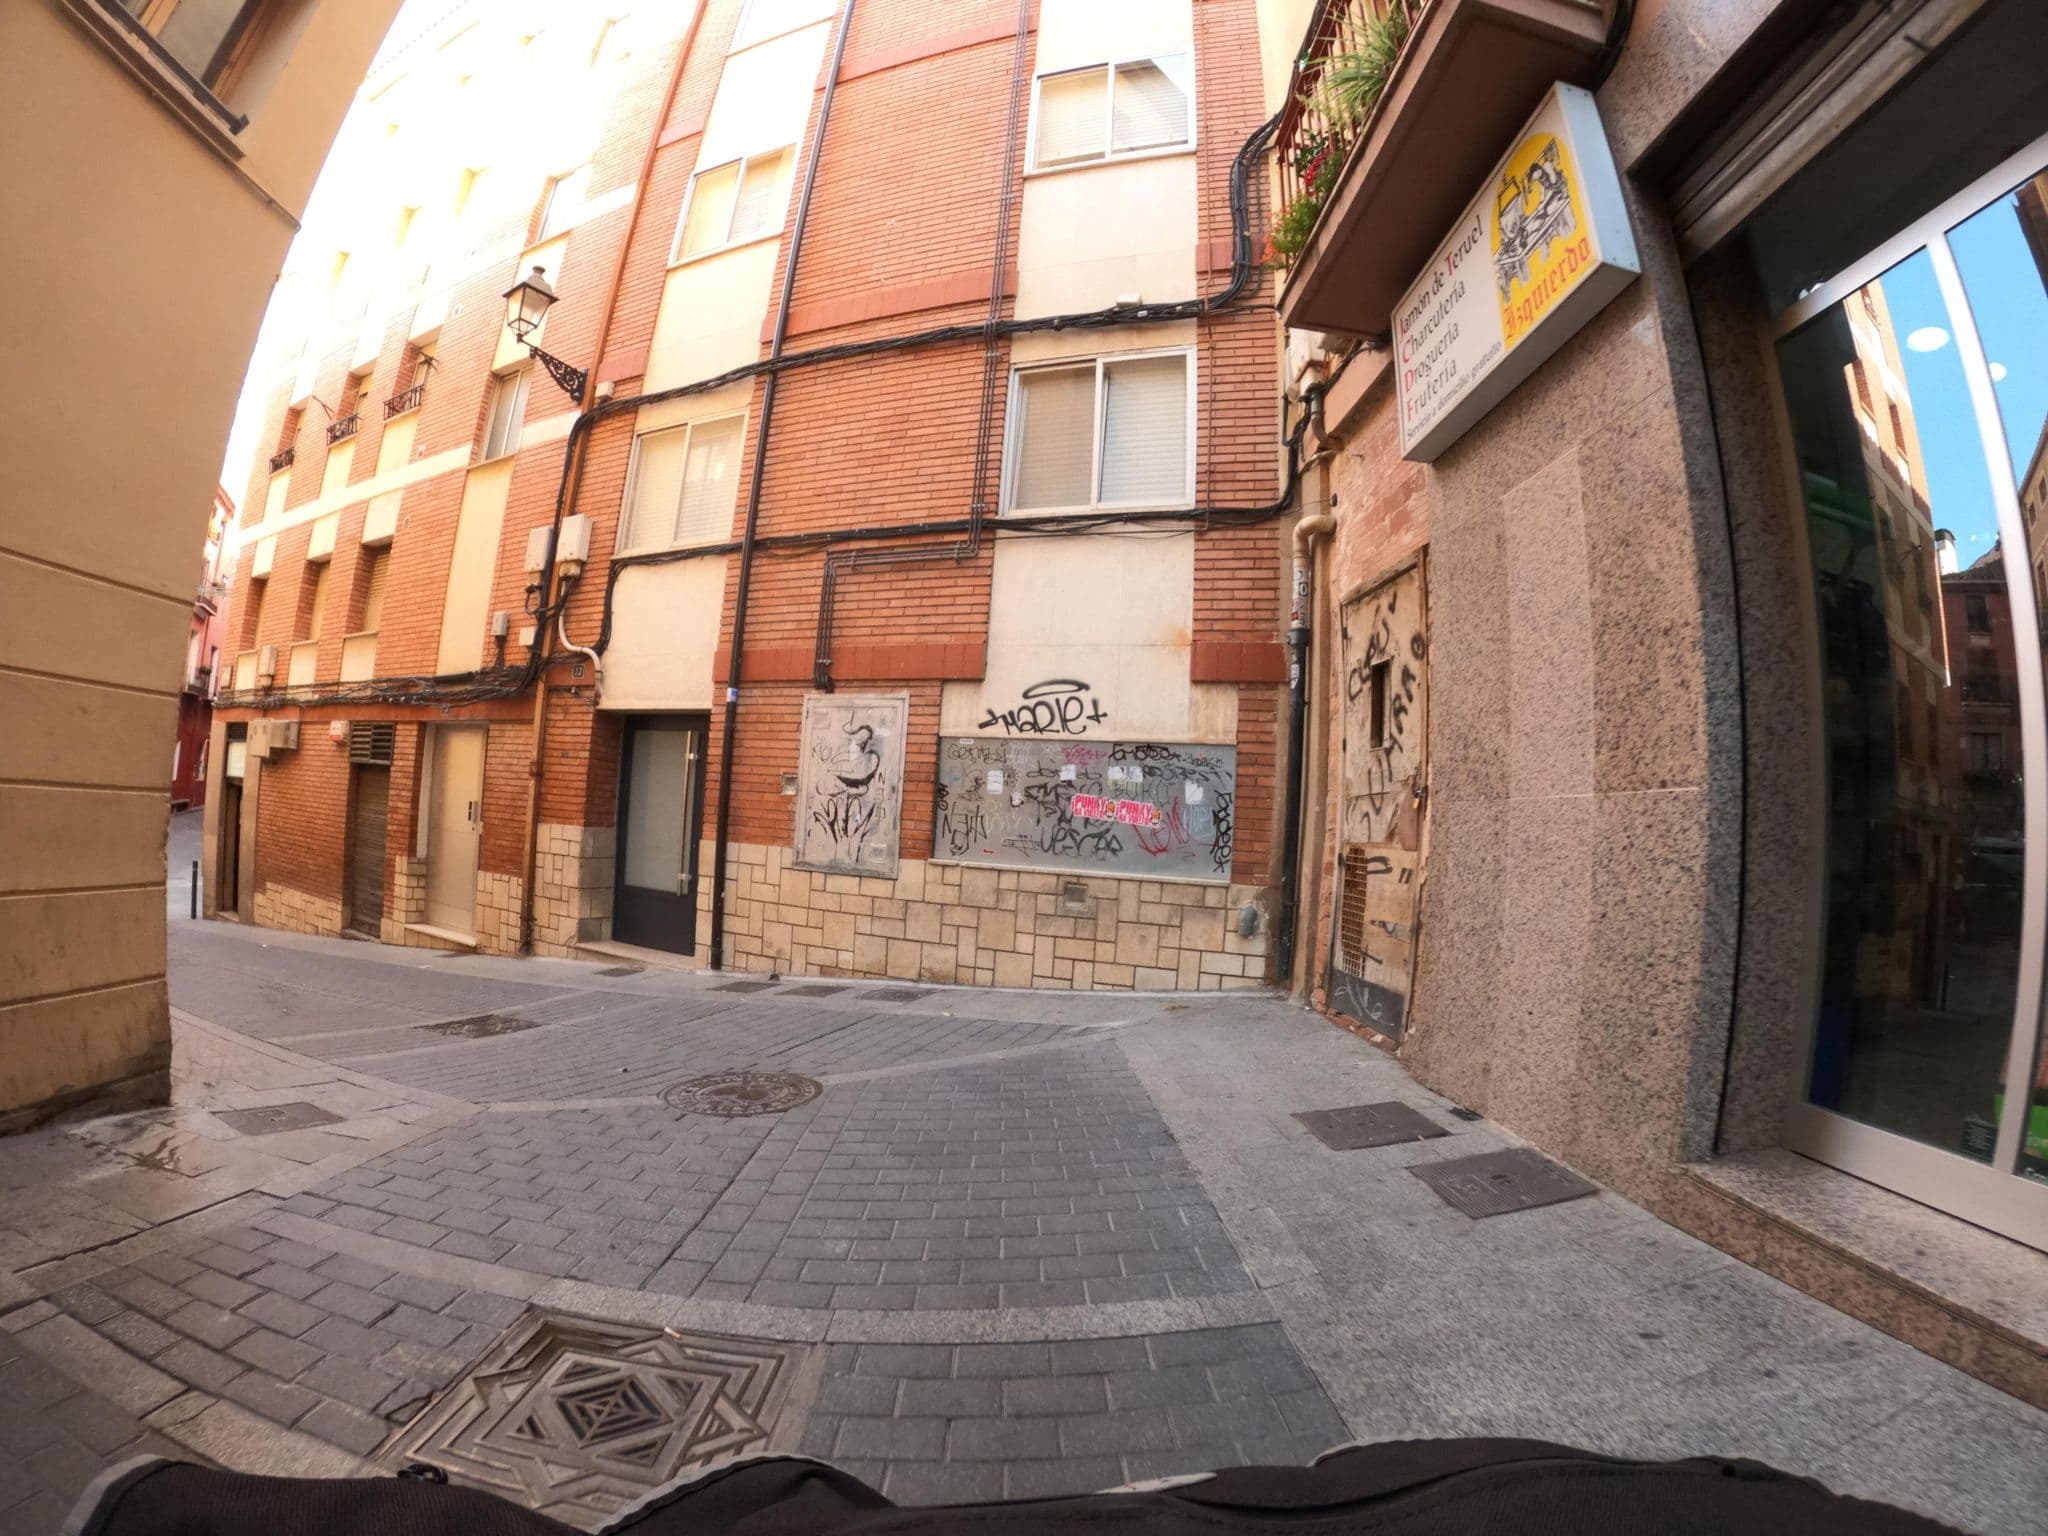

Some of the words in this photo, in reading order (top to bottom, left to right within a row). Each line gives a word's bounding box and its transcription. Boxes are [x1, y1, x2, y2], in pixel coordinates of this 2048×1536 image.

[1431, 271, 1445, 295] de
[1444, 214, 1483, 276] Teruel
[1503, 236, 1590, 339] Izquierdo
[1402, 280, 1466, 364] Charcutería
[1404, 322, 1459, 393] Droguería
[1407, 359, 1457, 422] Frutería
